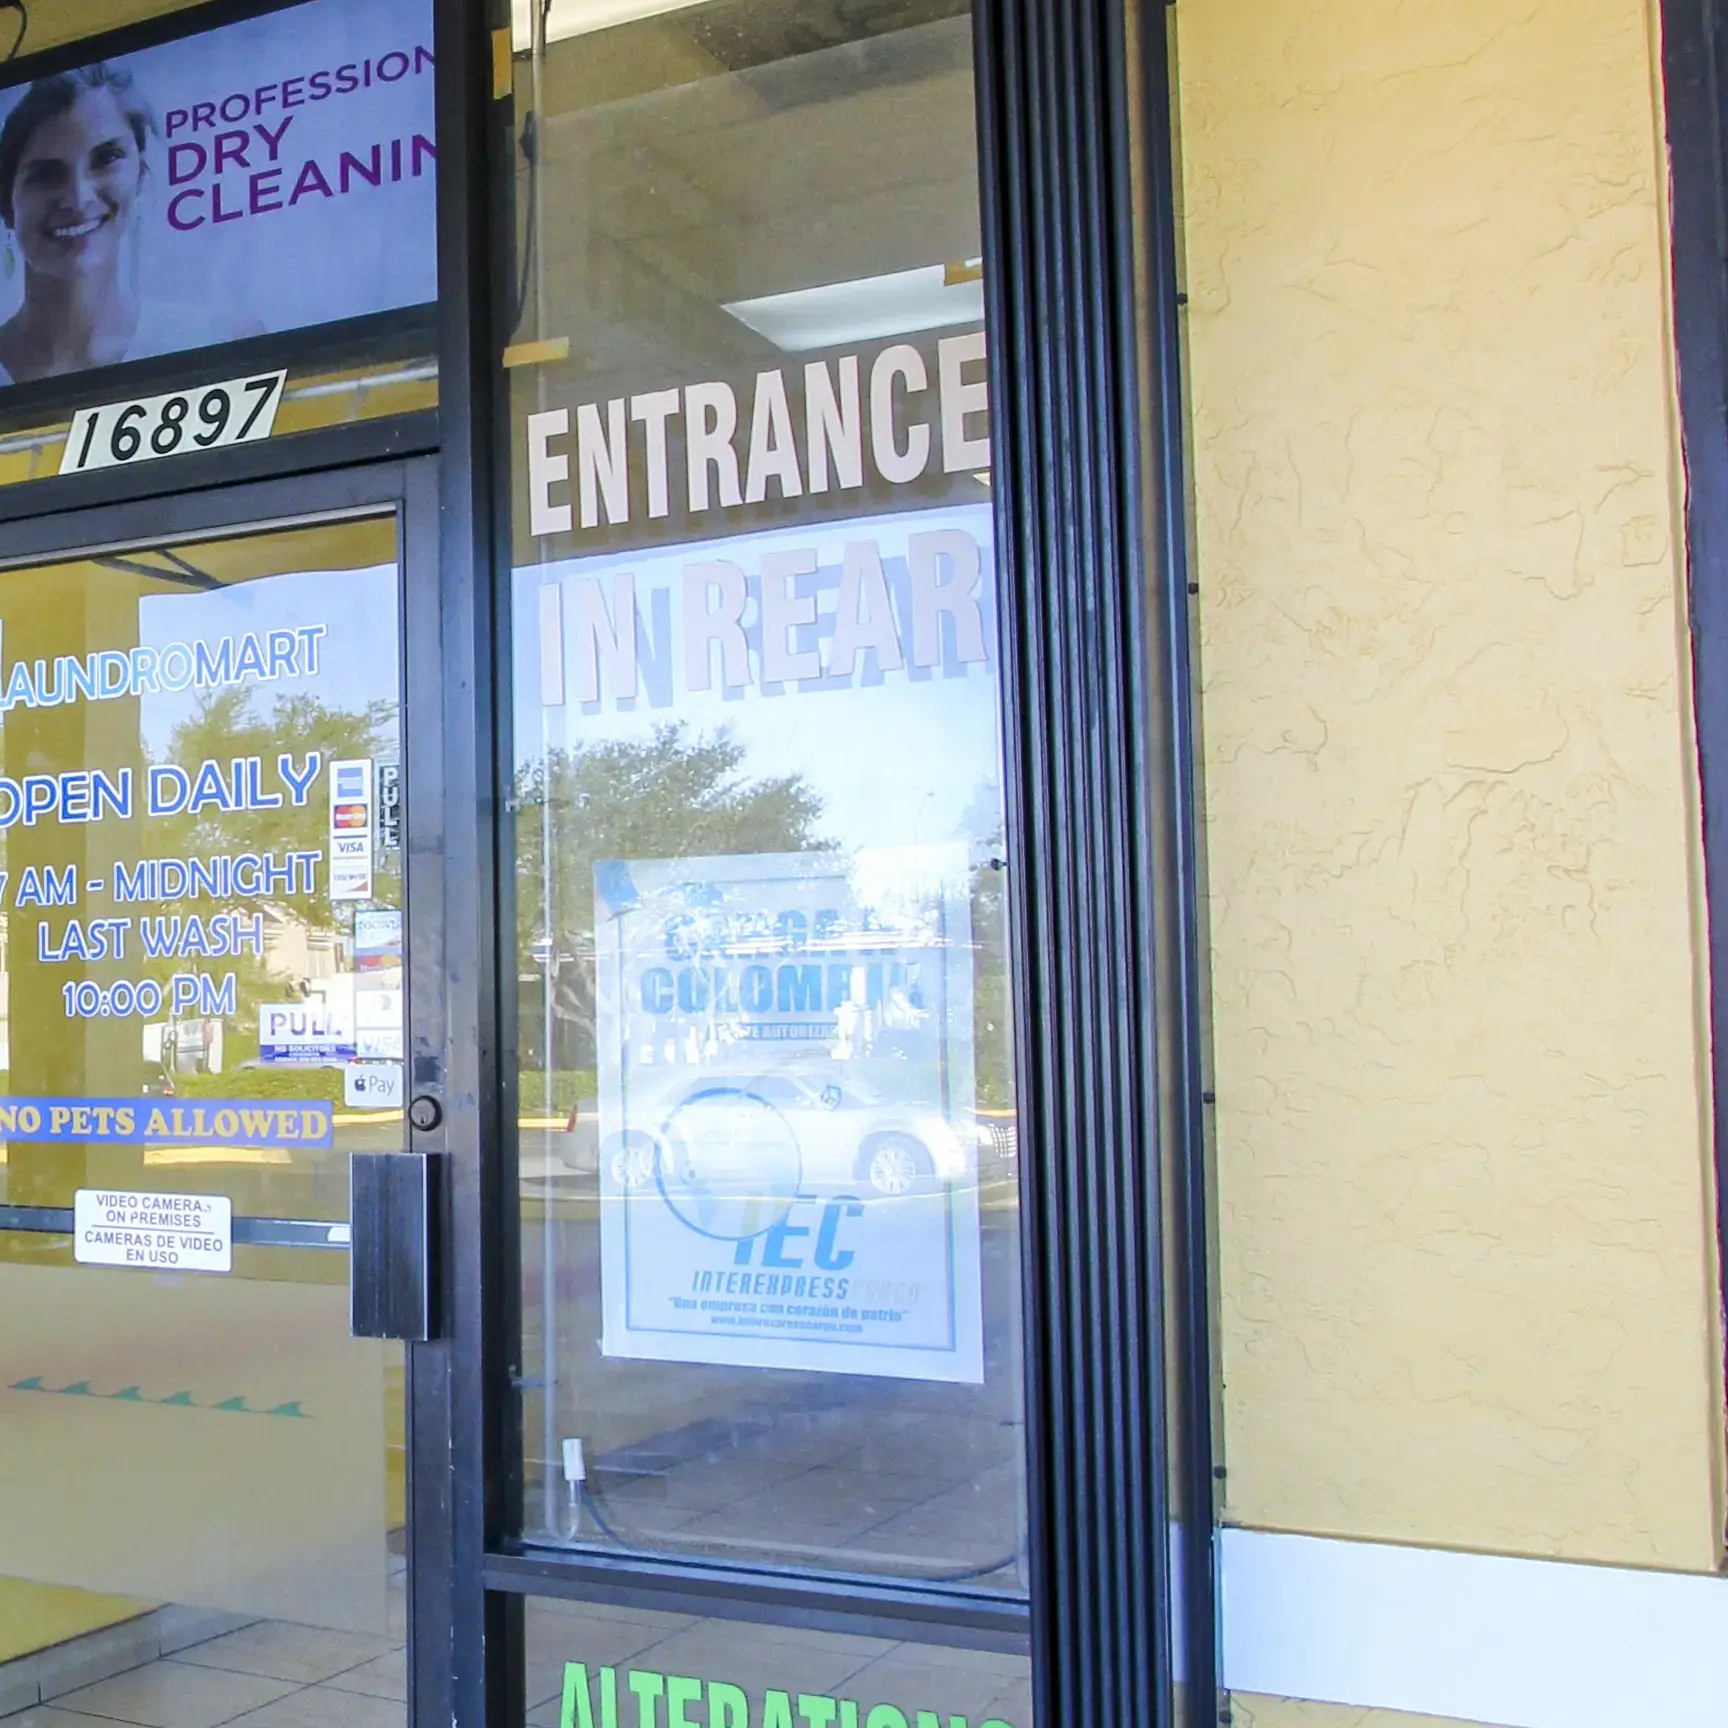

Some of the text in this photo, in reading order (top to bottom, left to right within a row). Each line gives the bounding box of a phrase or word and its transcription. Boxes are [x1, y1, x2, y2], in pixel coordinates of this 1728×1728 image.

[167, 116, 293, 186] DRY
[76, 376, 278, 469] 16897
[527, 331, 992, 537] ENTRANCE
[538, 528, 988, 706] IN REAR
[147, 751, 322, 817] DAILY
[337, 842, 364, 852] VISA
[15, 865, 78, 909] AM
[113, 851, 324, 904] MIDNIGHT
[37, 914, 264, 964] LAST WASH
[62, 972, 238, 1018] 10:00 PM
[270, 1012, 342, 1036] PULL
[369, 1075, 395, 1099] Pay
[49, 1106, 135, 1136] PETS
[144, 1109, 328, 1140] ALLOWED
[96, 1194, 138, 1208] VIDEO
[106, 1210, 202, 1228] ON PREMISES
[84, 1231, 223, 1252] CAMERAS DE VIDEO
[126, 1248, 179, 1265] EN USO
[692, 1270, 850, 1300] INTEREXPRESS
